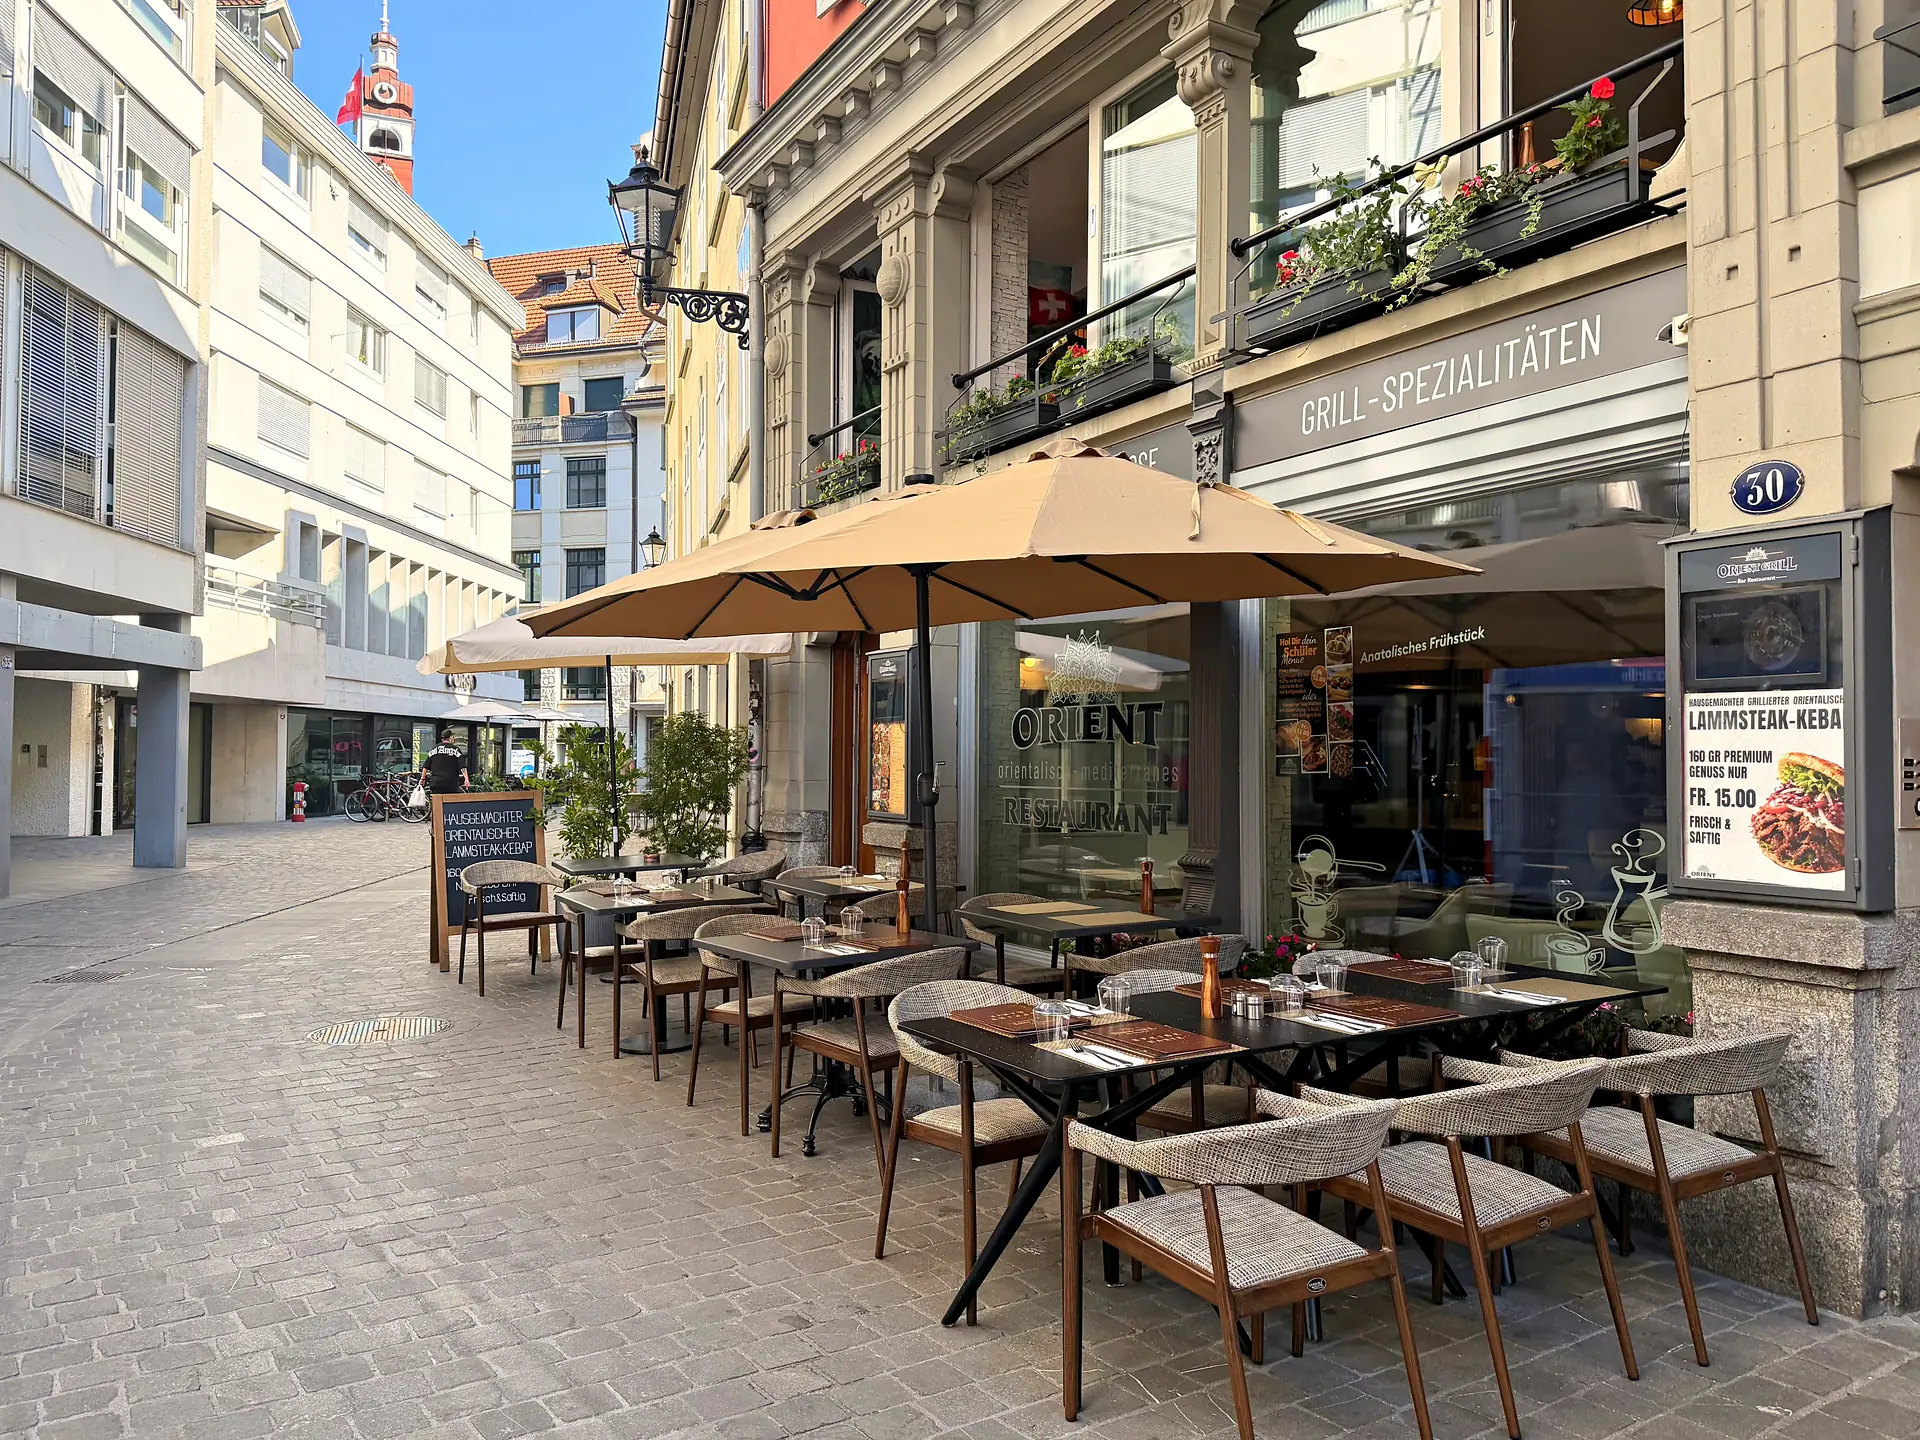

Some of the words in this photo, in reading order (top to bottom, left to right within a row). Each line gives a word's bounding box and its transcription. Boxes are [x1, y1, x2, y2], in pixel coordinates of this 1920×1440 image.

[1301, 314, 1601, 436] GRILL-SPEZIALITÄTEN
[1746, 467, 1785, 507] 30
[1717, 562, 1761, 579] ORIENT
[1761, 556, 1798, 572] GRILL
[1279, 638, 1291, 646] Hol
[1301, 633, 1317, 645] dein
[1359, 641, 1427, 665] Anatolisches
[1429, 625, 1485, 650] Frühstück
[1283, 645, 1318, 657] Schüler
[1689, 697, 1744, 708] HAUSGEMACHTER
[1747, 696, 1790, 706] GRILLIERTER
[1011, 701, 1165, 750] ORIENT
[1689, 708, 1842, 731] LAMMSTEAK-KEBA
[1689, 750, 1706, 763] 160
[1708, 750, 1721, 763] GR
[1723, 750, 1773, 763] PREMIUM
[998, 761, 1070, 781] orientalisc
[1689, 766, 1725, 779] GENUSS
[1727, 766, 1748, 779] NUR
[1689, 787, 1711, 807] FR.
[1714, 788, 1757, 808] 15.00
[443, 811, 524, 826] HAUSGEMACHTER
[1002, 797, 1173, 836] RESTAURANT
[1689, 815, 1722, 830] FRISCH
[1724, 818, 1732, 831] &
[444, 827, 520, 842] ORIENTALISCHER
[1689, 831, 1721, 845] SAFTIG
[445, 841, 533, 859] LAMMSTEAK-KEBAP
[1690, 871, 1717, 879] ORIENT
[468, 891, 526, 905] Frsch&Saftig
